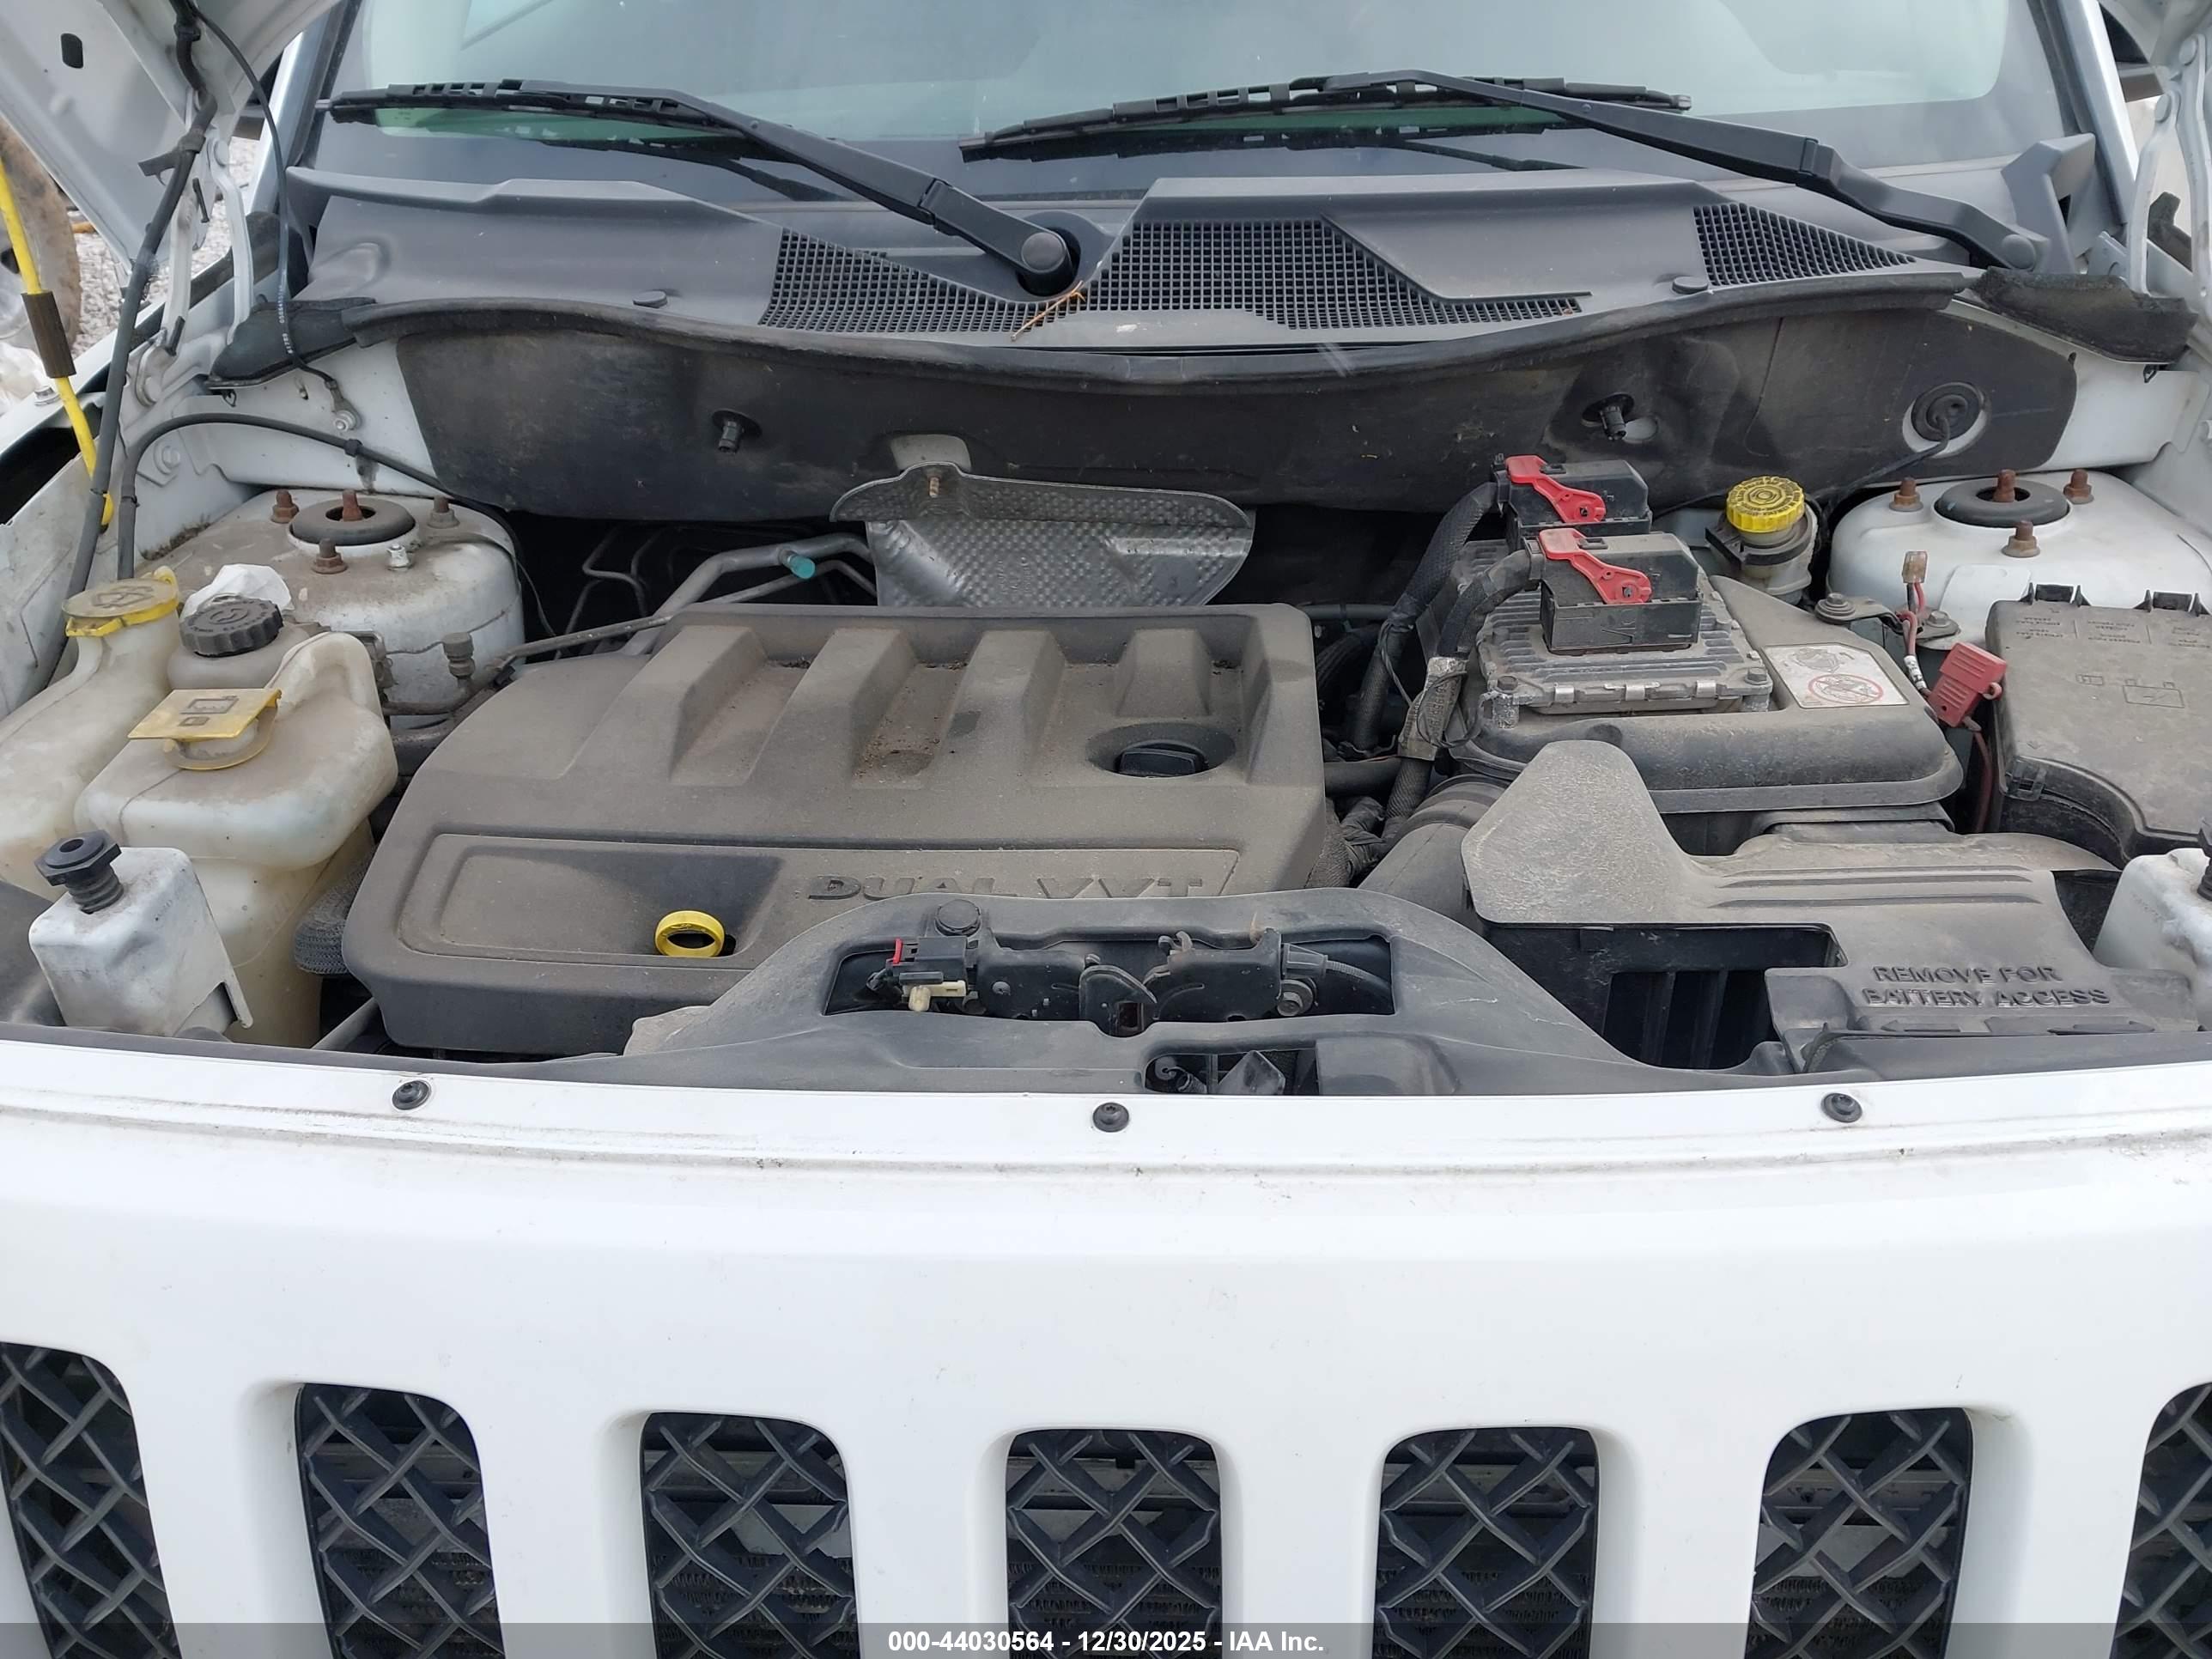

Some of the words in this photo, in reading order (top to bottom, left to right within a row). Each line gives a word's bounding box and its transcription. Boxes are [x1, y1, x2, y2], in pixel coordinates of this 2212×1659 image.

[807, 874, 1018, 901] DUAL
[1036, 878, 1203, 899] VVT
[1872, 965, 1994, 985] REMOVE
[1998, 965, 2063, 983] FOR
[1862, 988, 1983, 1007] BATTERY
[1995, 988, 2111, 1008] ACCESS
